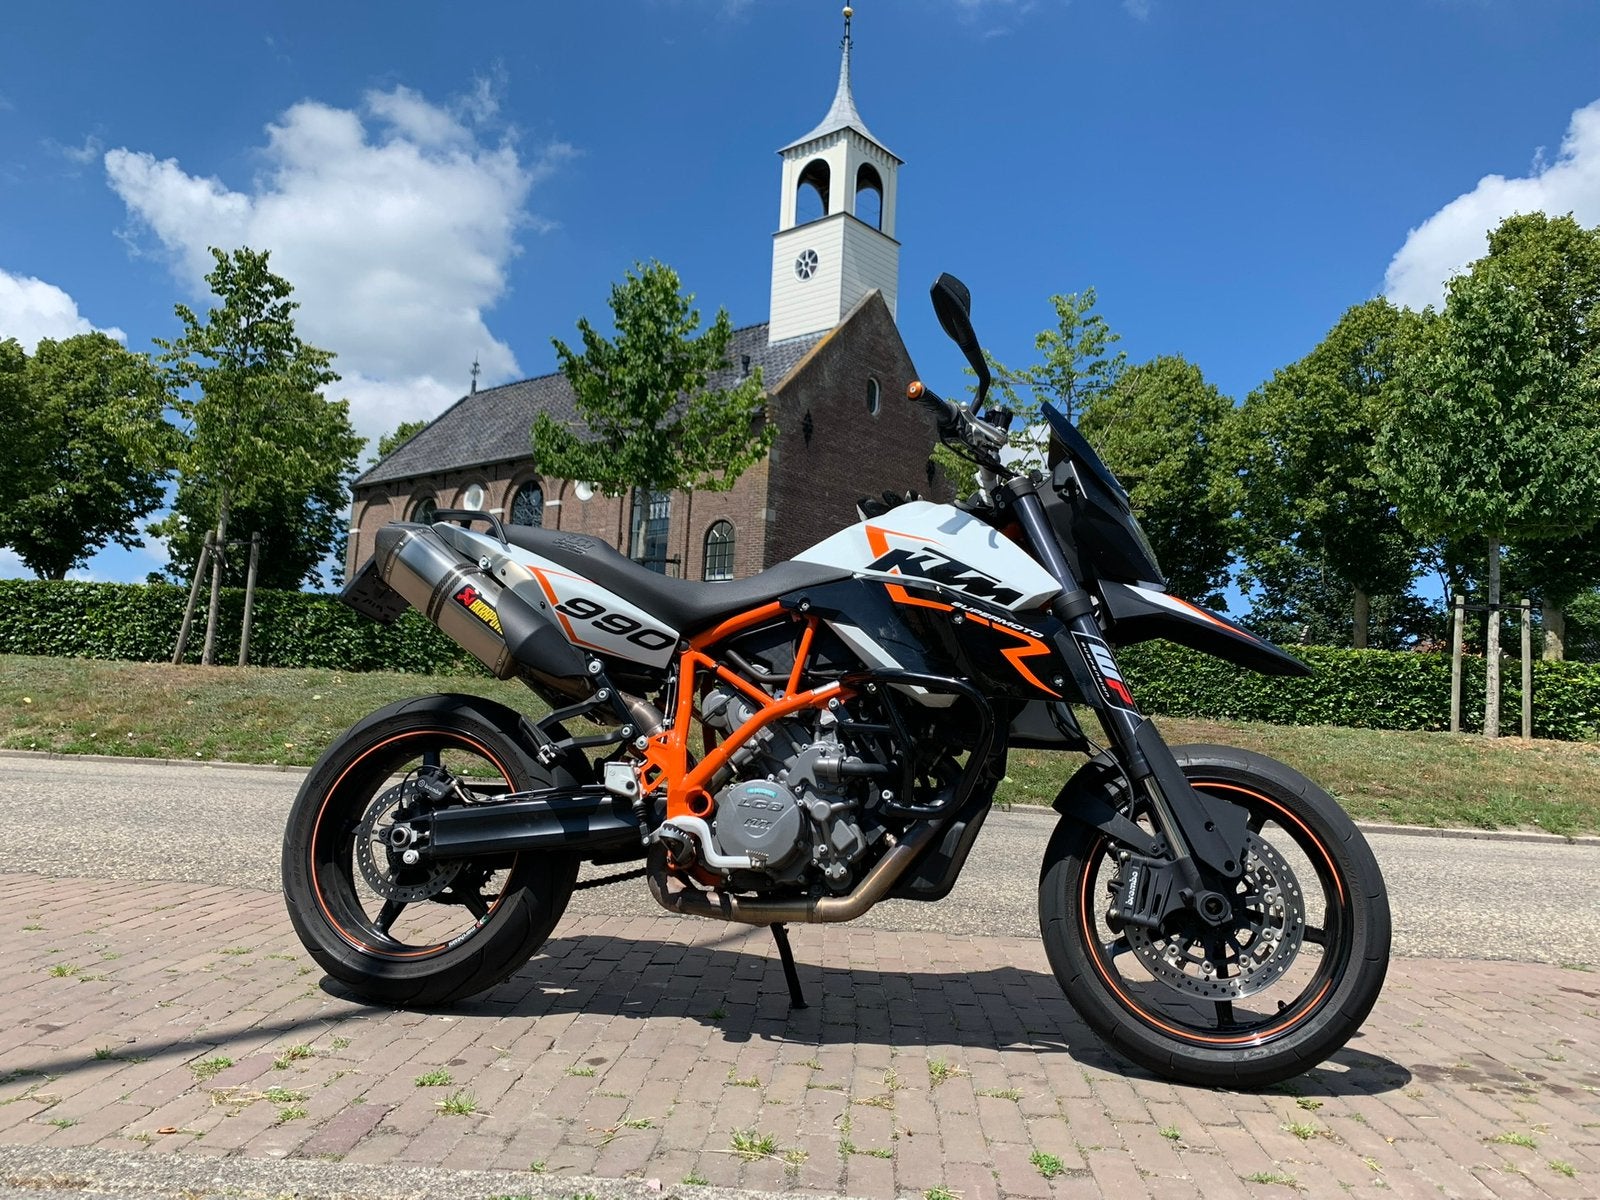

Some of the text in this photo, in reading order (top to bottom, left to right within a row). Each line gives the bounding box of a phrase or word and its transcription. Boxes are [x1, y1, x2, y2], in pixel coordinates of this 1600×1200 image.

[865, 547, 1024, 606] KTM
[555, 598, 677, 650] 990
[951, 602, 1044, 637] SUPERMOTO
[1088, 643, 1133, 705] WP
[1125, 871, 1138, 906] brembo
